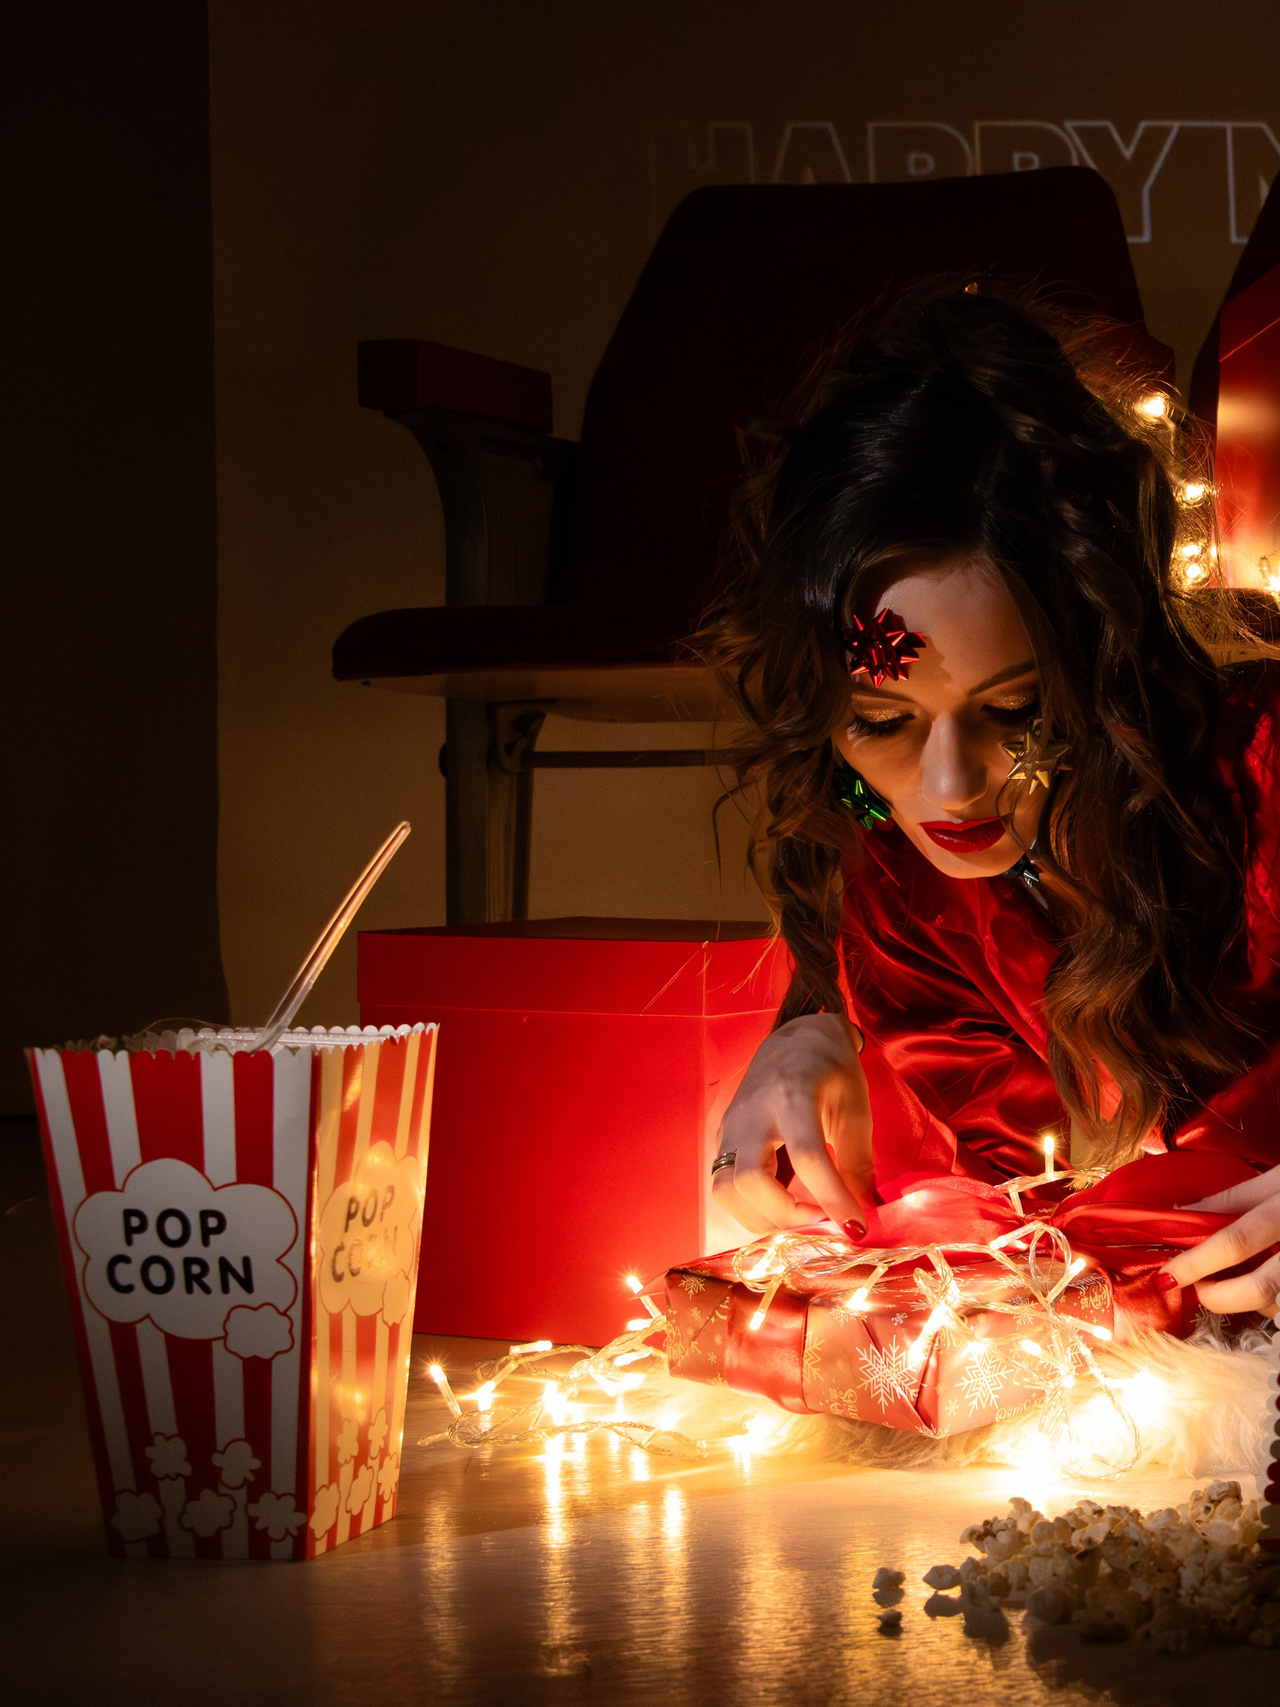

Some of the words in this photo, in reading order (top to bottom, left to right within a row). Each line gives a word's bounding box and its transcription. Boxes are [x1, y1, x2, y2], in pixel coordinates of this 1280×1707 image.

[122, 1207, 228, 1249] POP
[344, 1185, 395, 1233] POP
[106, 1254, 255, 1295] CORN
